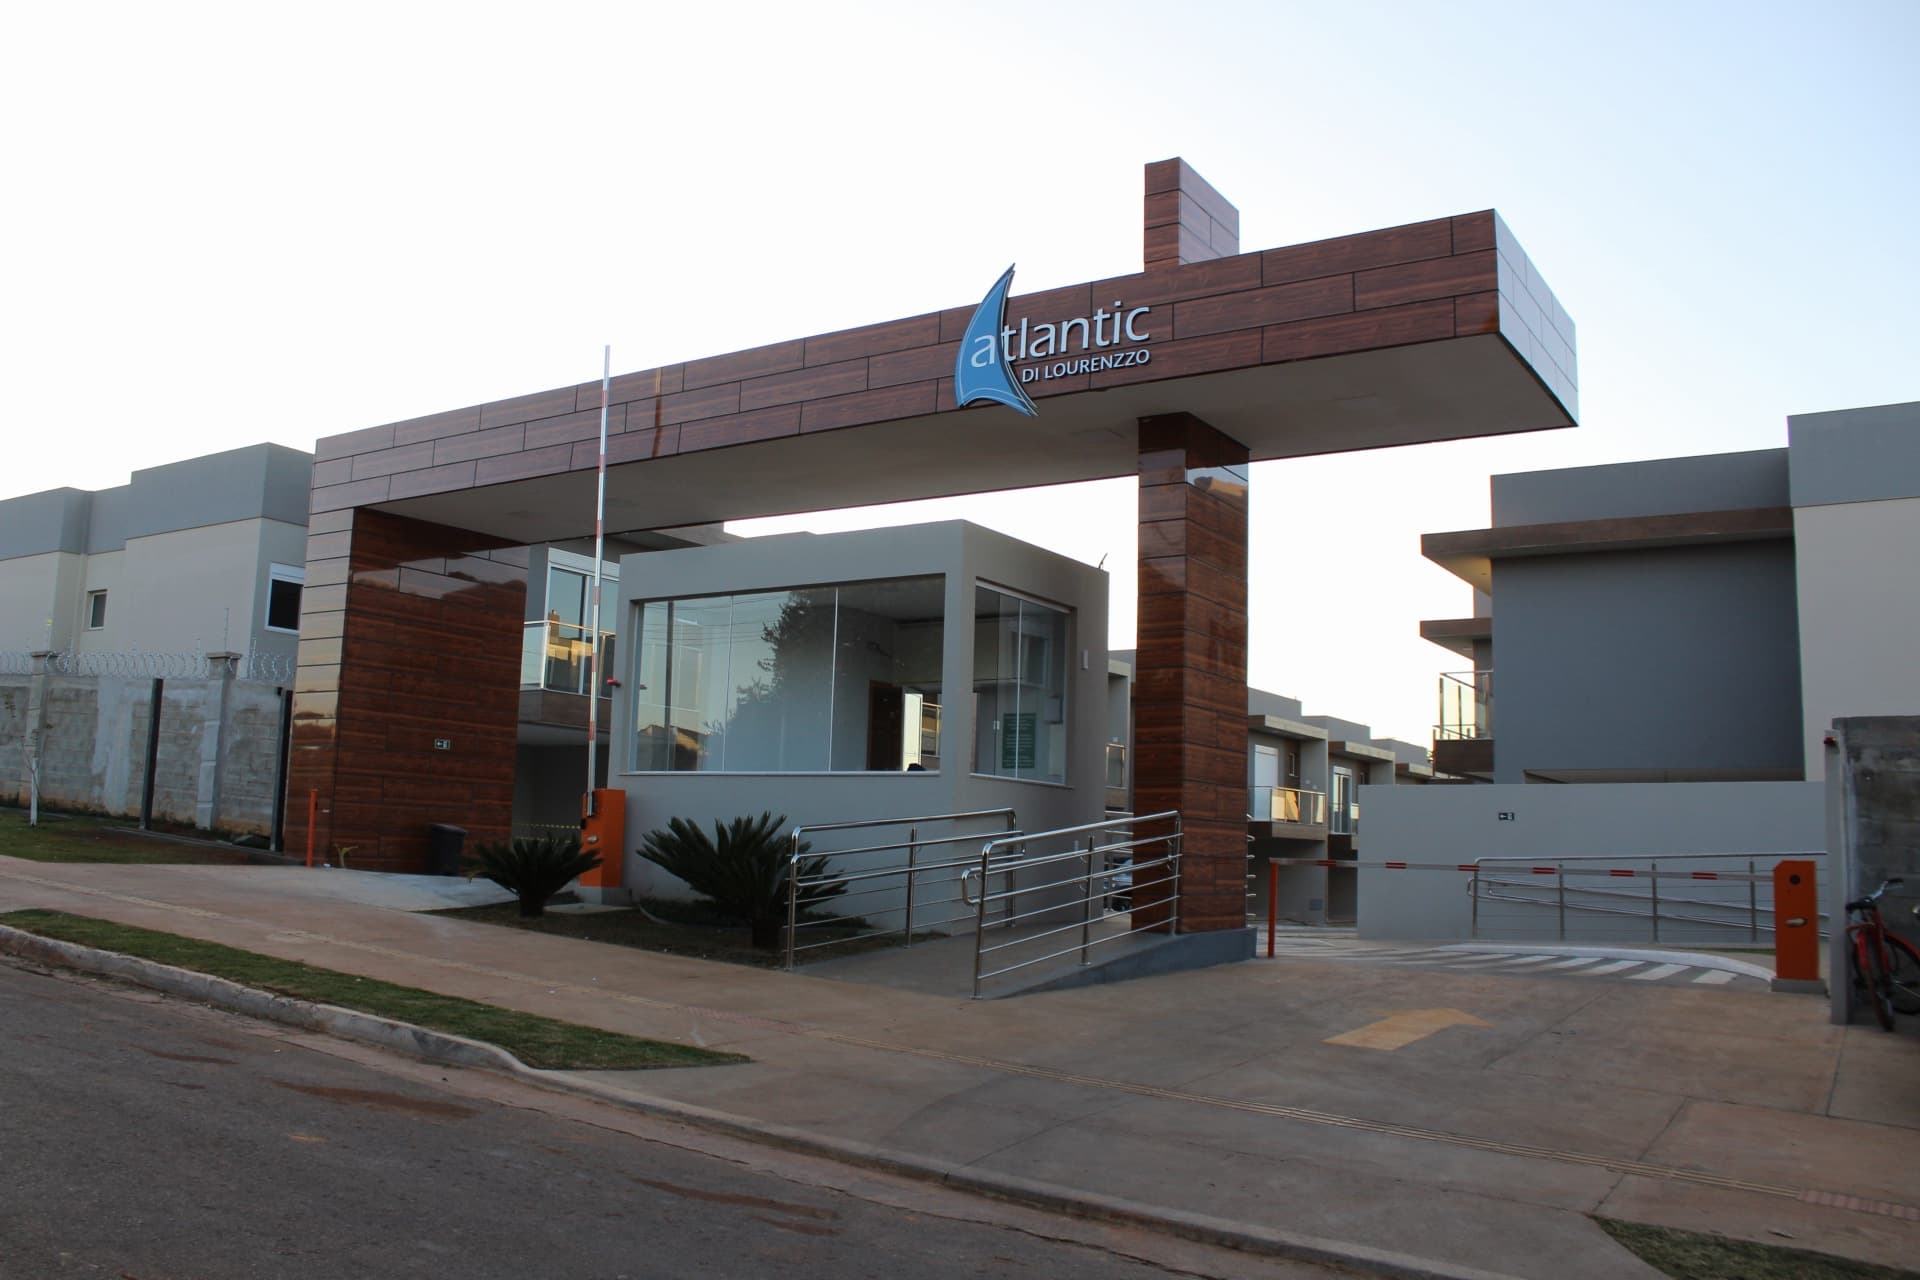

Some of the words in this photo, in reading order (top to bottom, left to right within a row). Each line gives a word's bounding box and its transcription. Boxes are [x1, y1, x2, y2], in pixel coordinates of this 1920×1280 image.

[971, 301, 1150, 367] atlantic
[1021, 367, 1040, 383] DI
[1044, 349, 1150, 380] LOURENZZO
